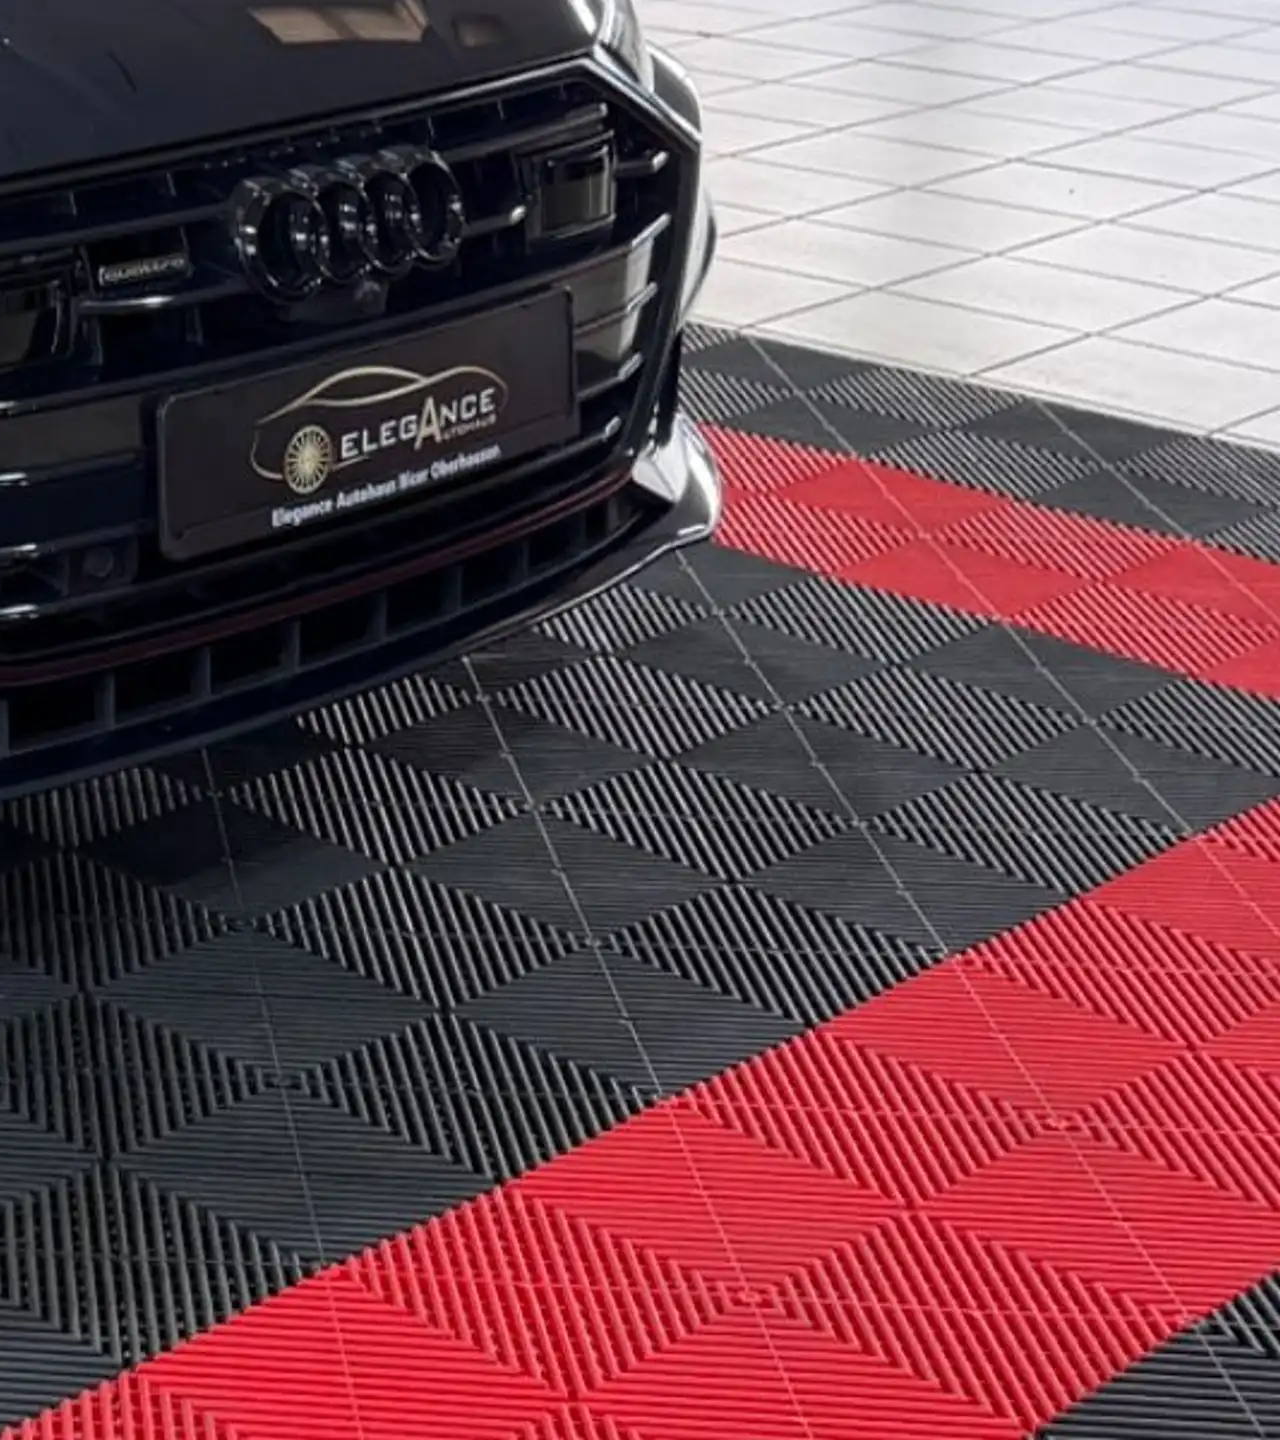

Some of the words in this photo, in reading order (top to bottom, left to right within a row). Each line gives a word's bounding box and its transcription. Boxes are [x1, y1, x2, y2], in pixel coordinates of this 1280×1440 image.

[341, 388, 496, 460] ELEGANCE
[272, 498, 333, 529] Elegance
[337, 480, 397, 510] Autohaus
[430, 444, 501, 480] Oberhausen
